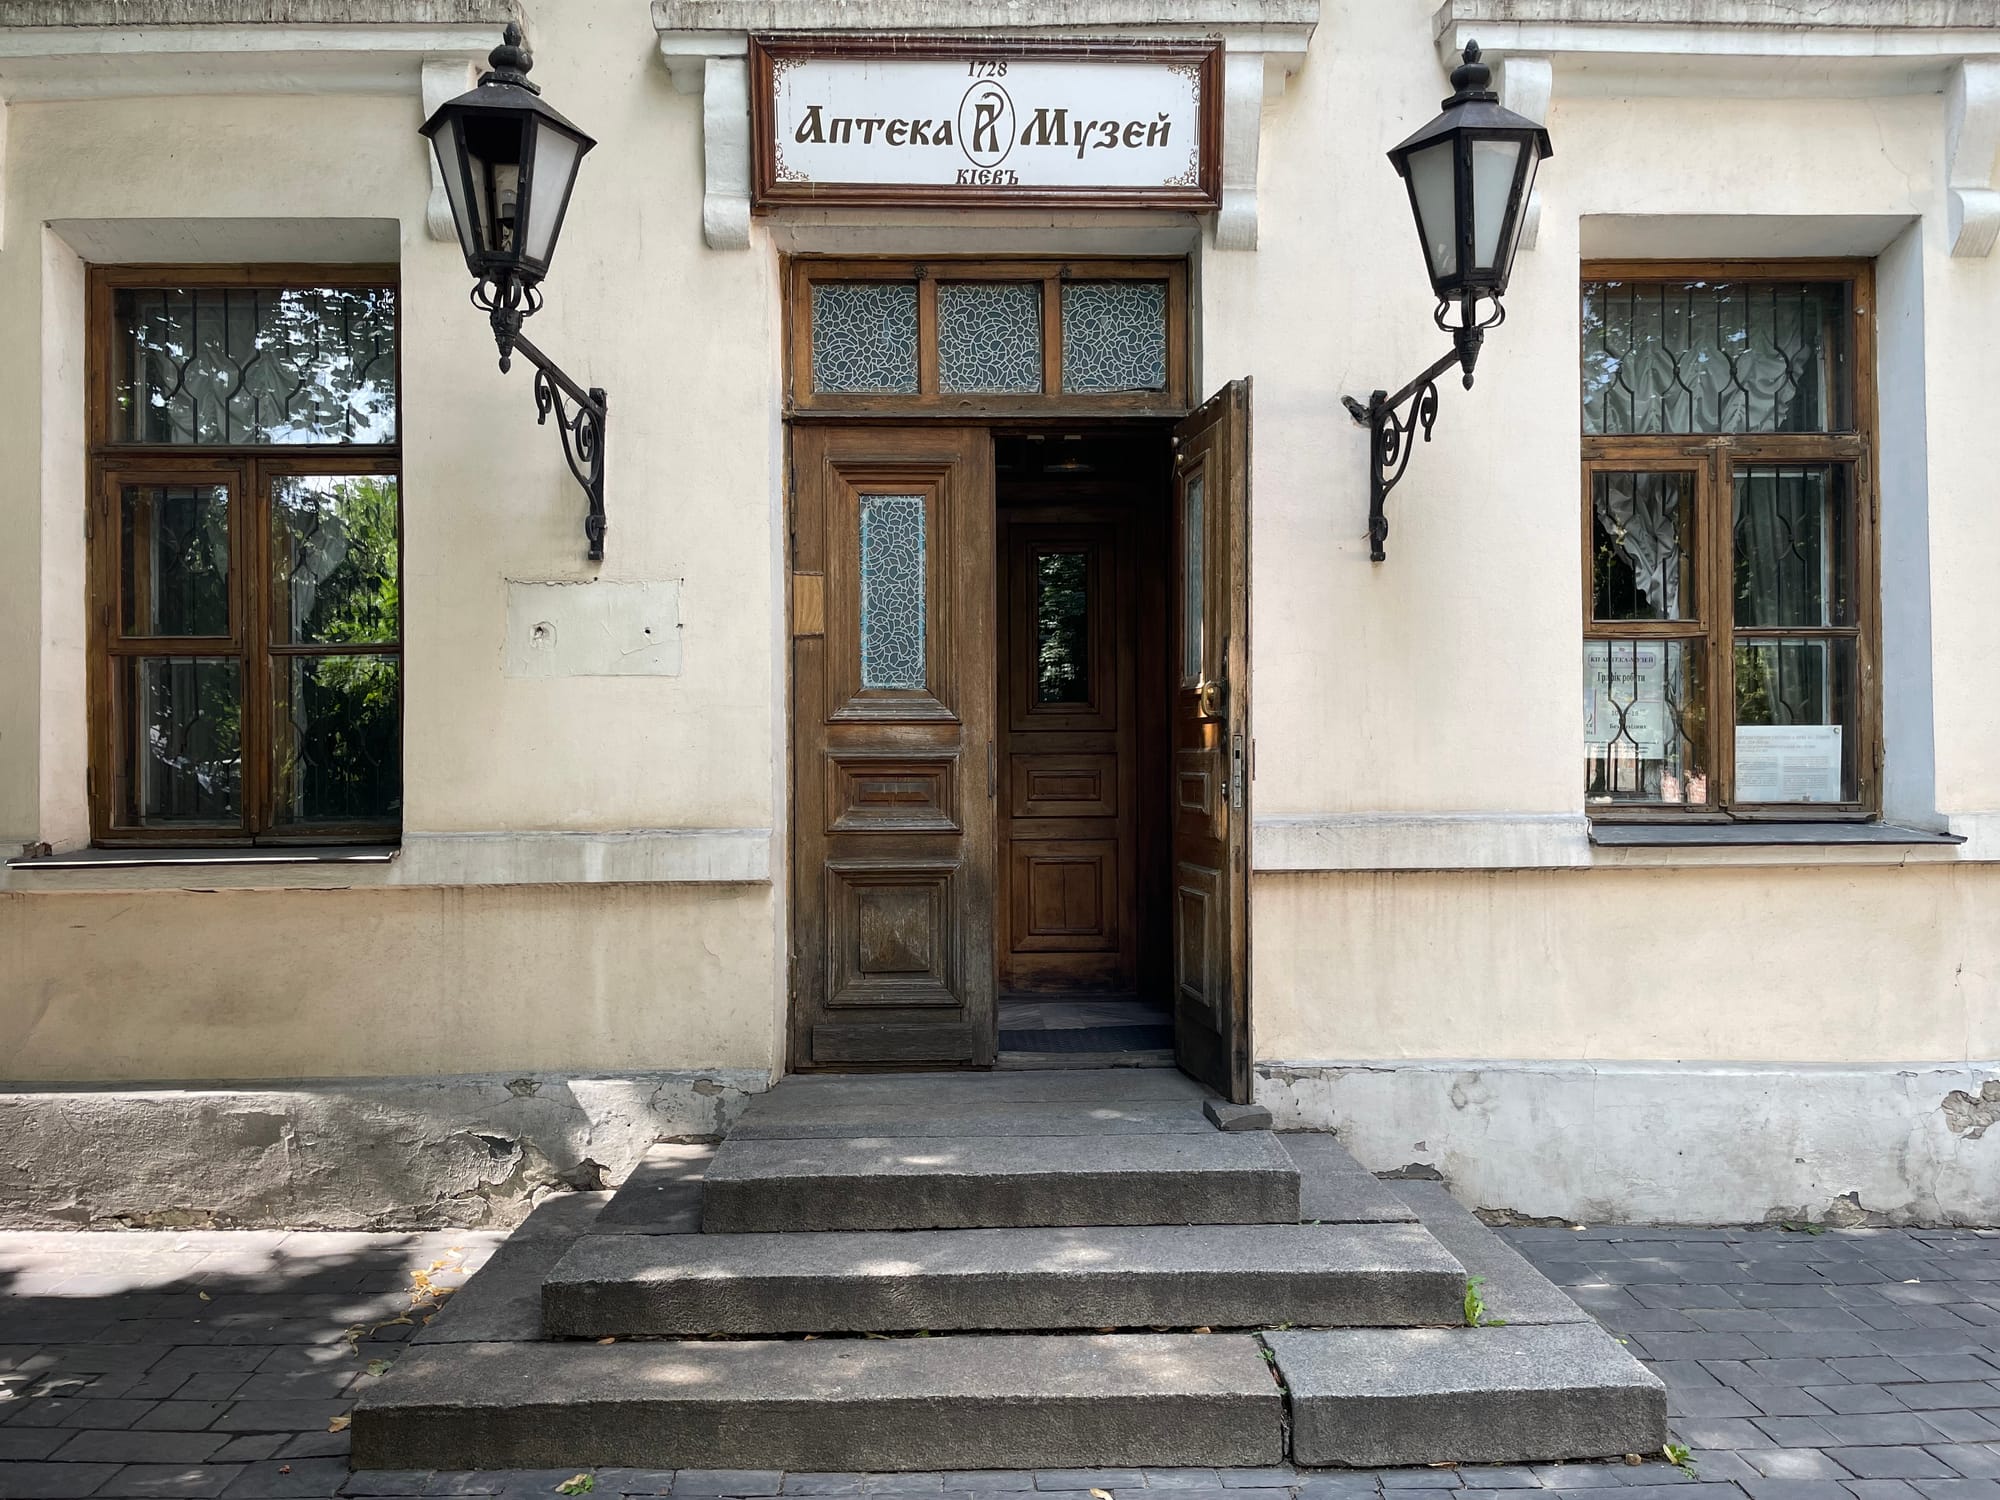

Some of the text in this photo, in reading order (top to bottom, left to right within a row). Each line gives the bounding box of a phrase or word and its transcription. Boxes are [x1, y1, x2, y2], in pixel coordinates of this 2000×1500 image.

[967, 61, 1008, 78] 1728
[794, 105, 954, 146] Аптека
[1020, 109, 1171, 159] Музей
